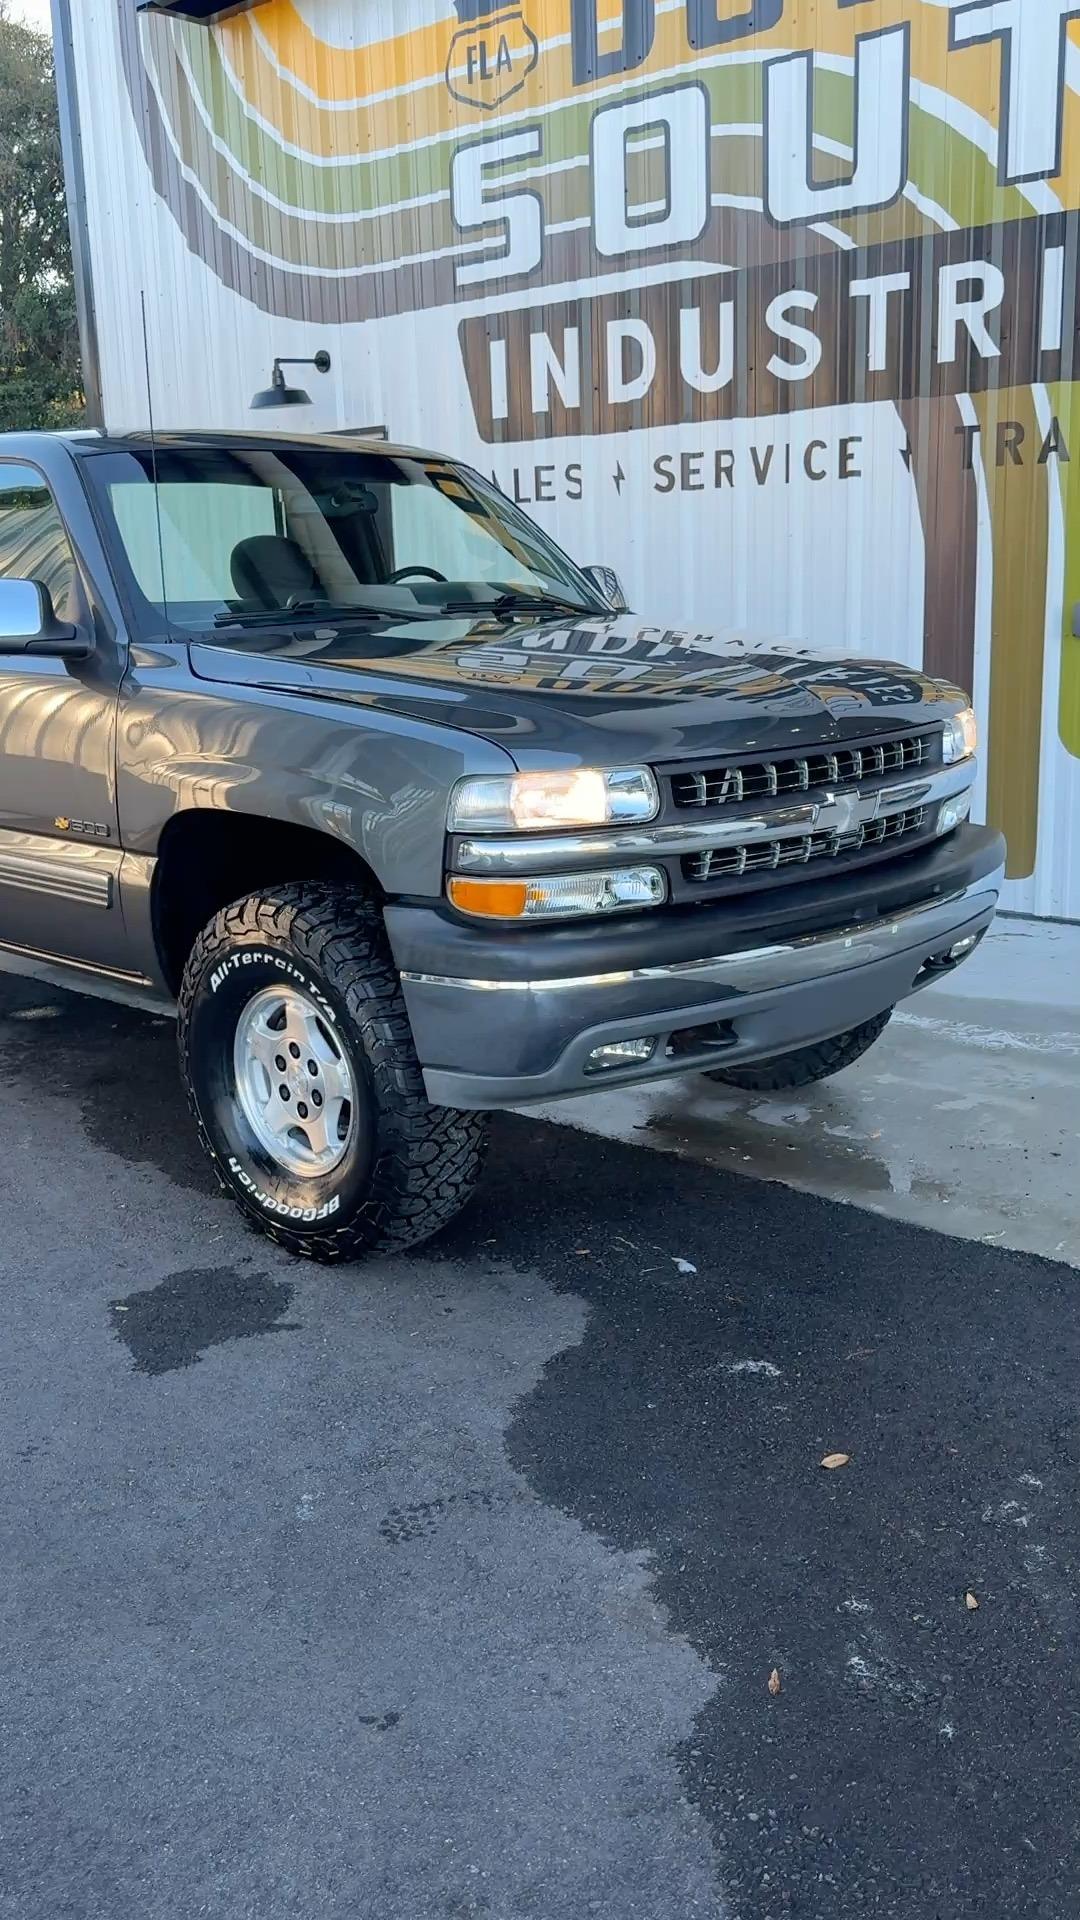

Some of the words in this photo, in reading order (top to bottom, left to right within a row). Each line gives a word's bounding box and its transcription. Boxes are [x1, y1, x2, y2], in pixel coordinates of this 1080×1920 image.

[466, 34, 512, 84] FLA
[489, 246, 1064, 419] INDUSTRI
[491, 463, 582, 503] LES
[652, 436, 862, 495] SERVICE
[954, 416, 1070, 470] TRA
[209, 951, 305, 993] All-Terrain
[228, 1156, 340, 1222] BFGoodrich
